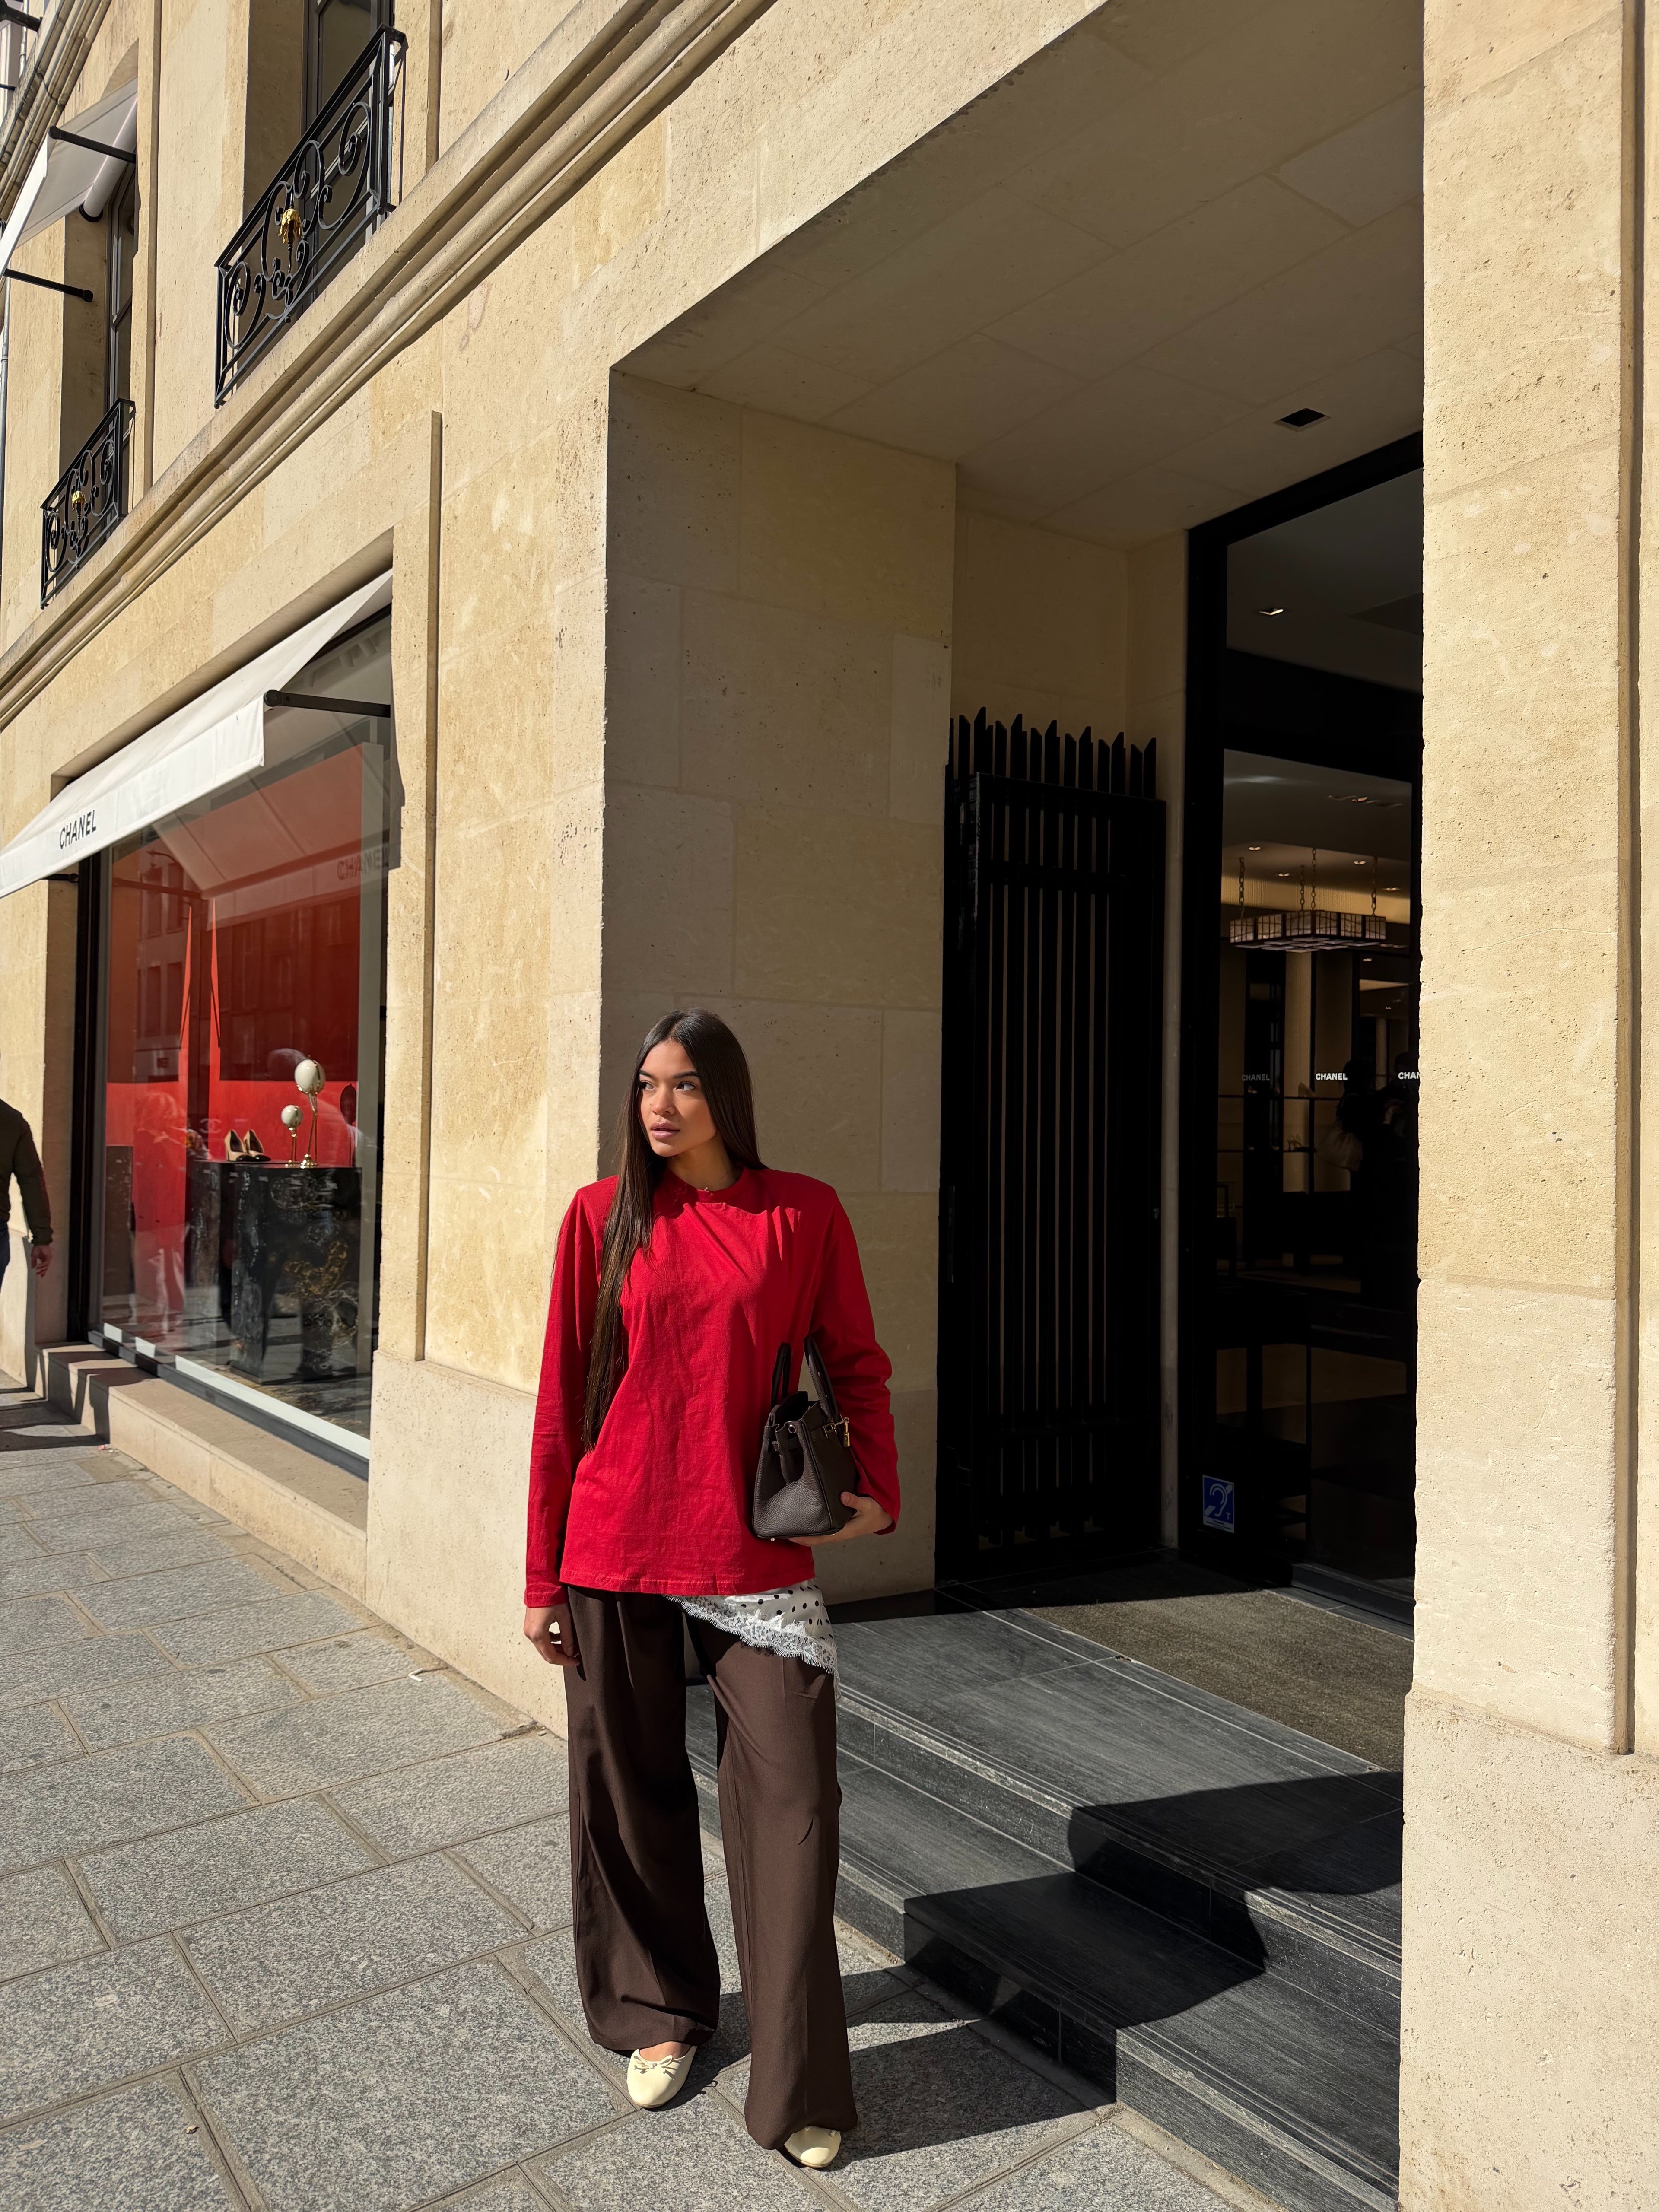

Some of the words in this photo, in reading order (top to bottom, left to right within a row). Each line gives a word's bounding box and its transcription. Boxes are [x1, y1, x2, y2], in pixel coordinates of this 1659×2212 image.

[60, 810, 96, 849] CHANEL
[337, 847, 389, 880] CHANEL
[1225, 1512, 1231, 1520] T
